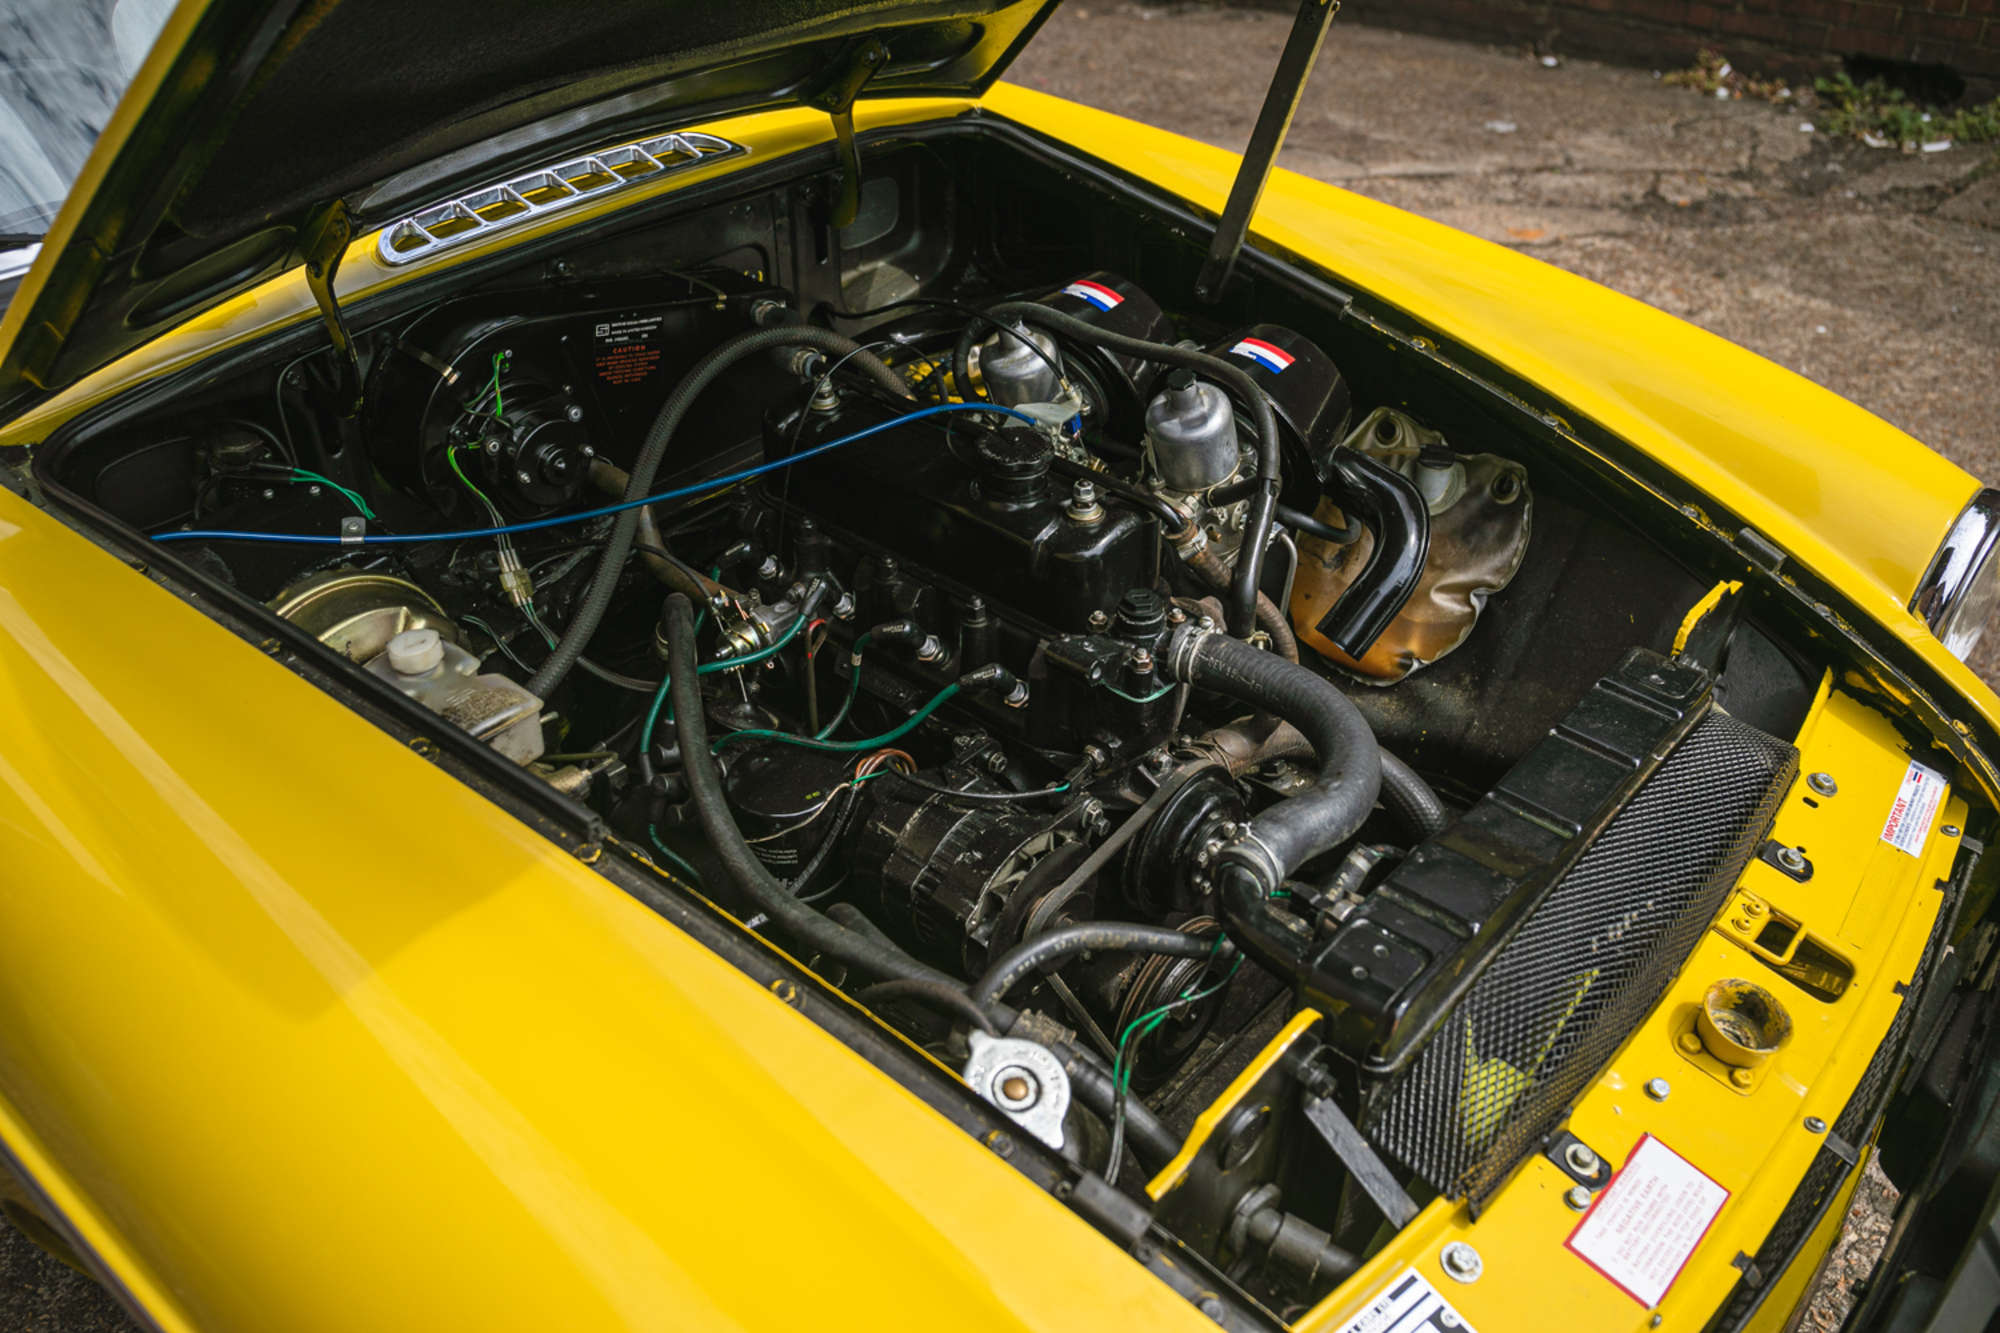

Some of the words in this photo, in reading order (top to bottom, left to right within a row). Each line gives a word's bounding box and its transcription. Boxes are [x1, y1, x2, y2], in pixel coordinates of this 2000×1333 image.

[613, 345, 646, 354] CAUTION
[1883, 797, 1908, 841] IMPORTANT
[1616, 1199, 1641, 1233] NEGATIVE
[1640, 1175, 1659, 1198] EARTH
